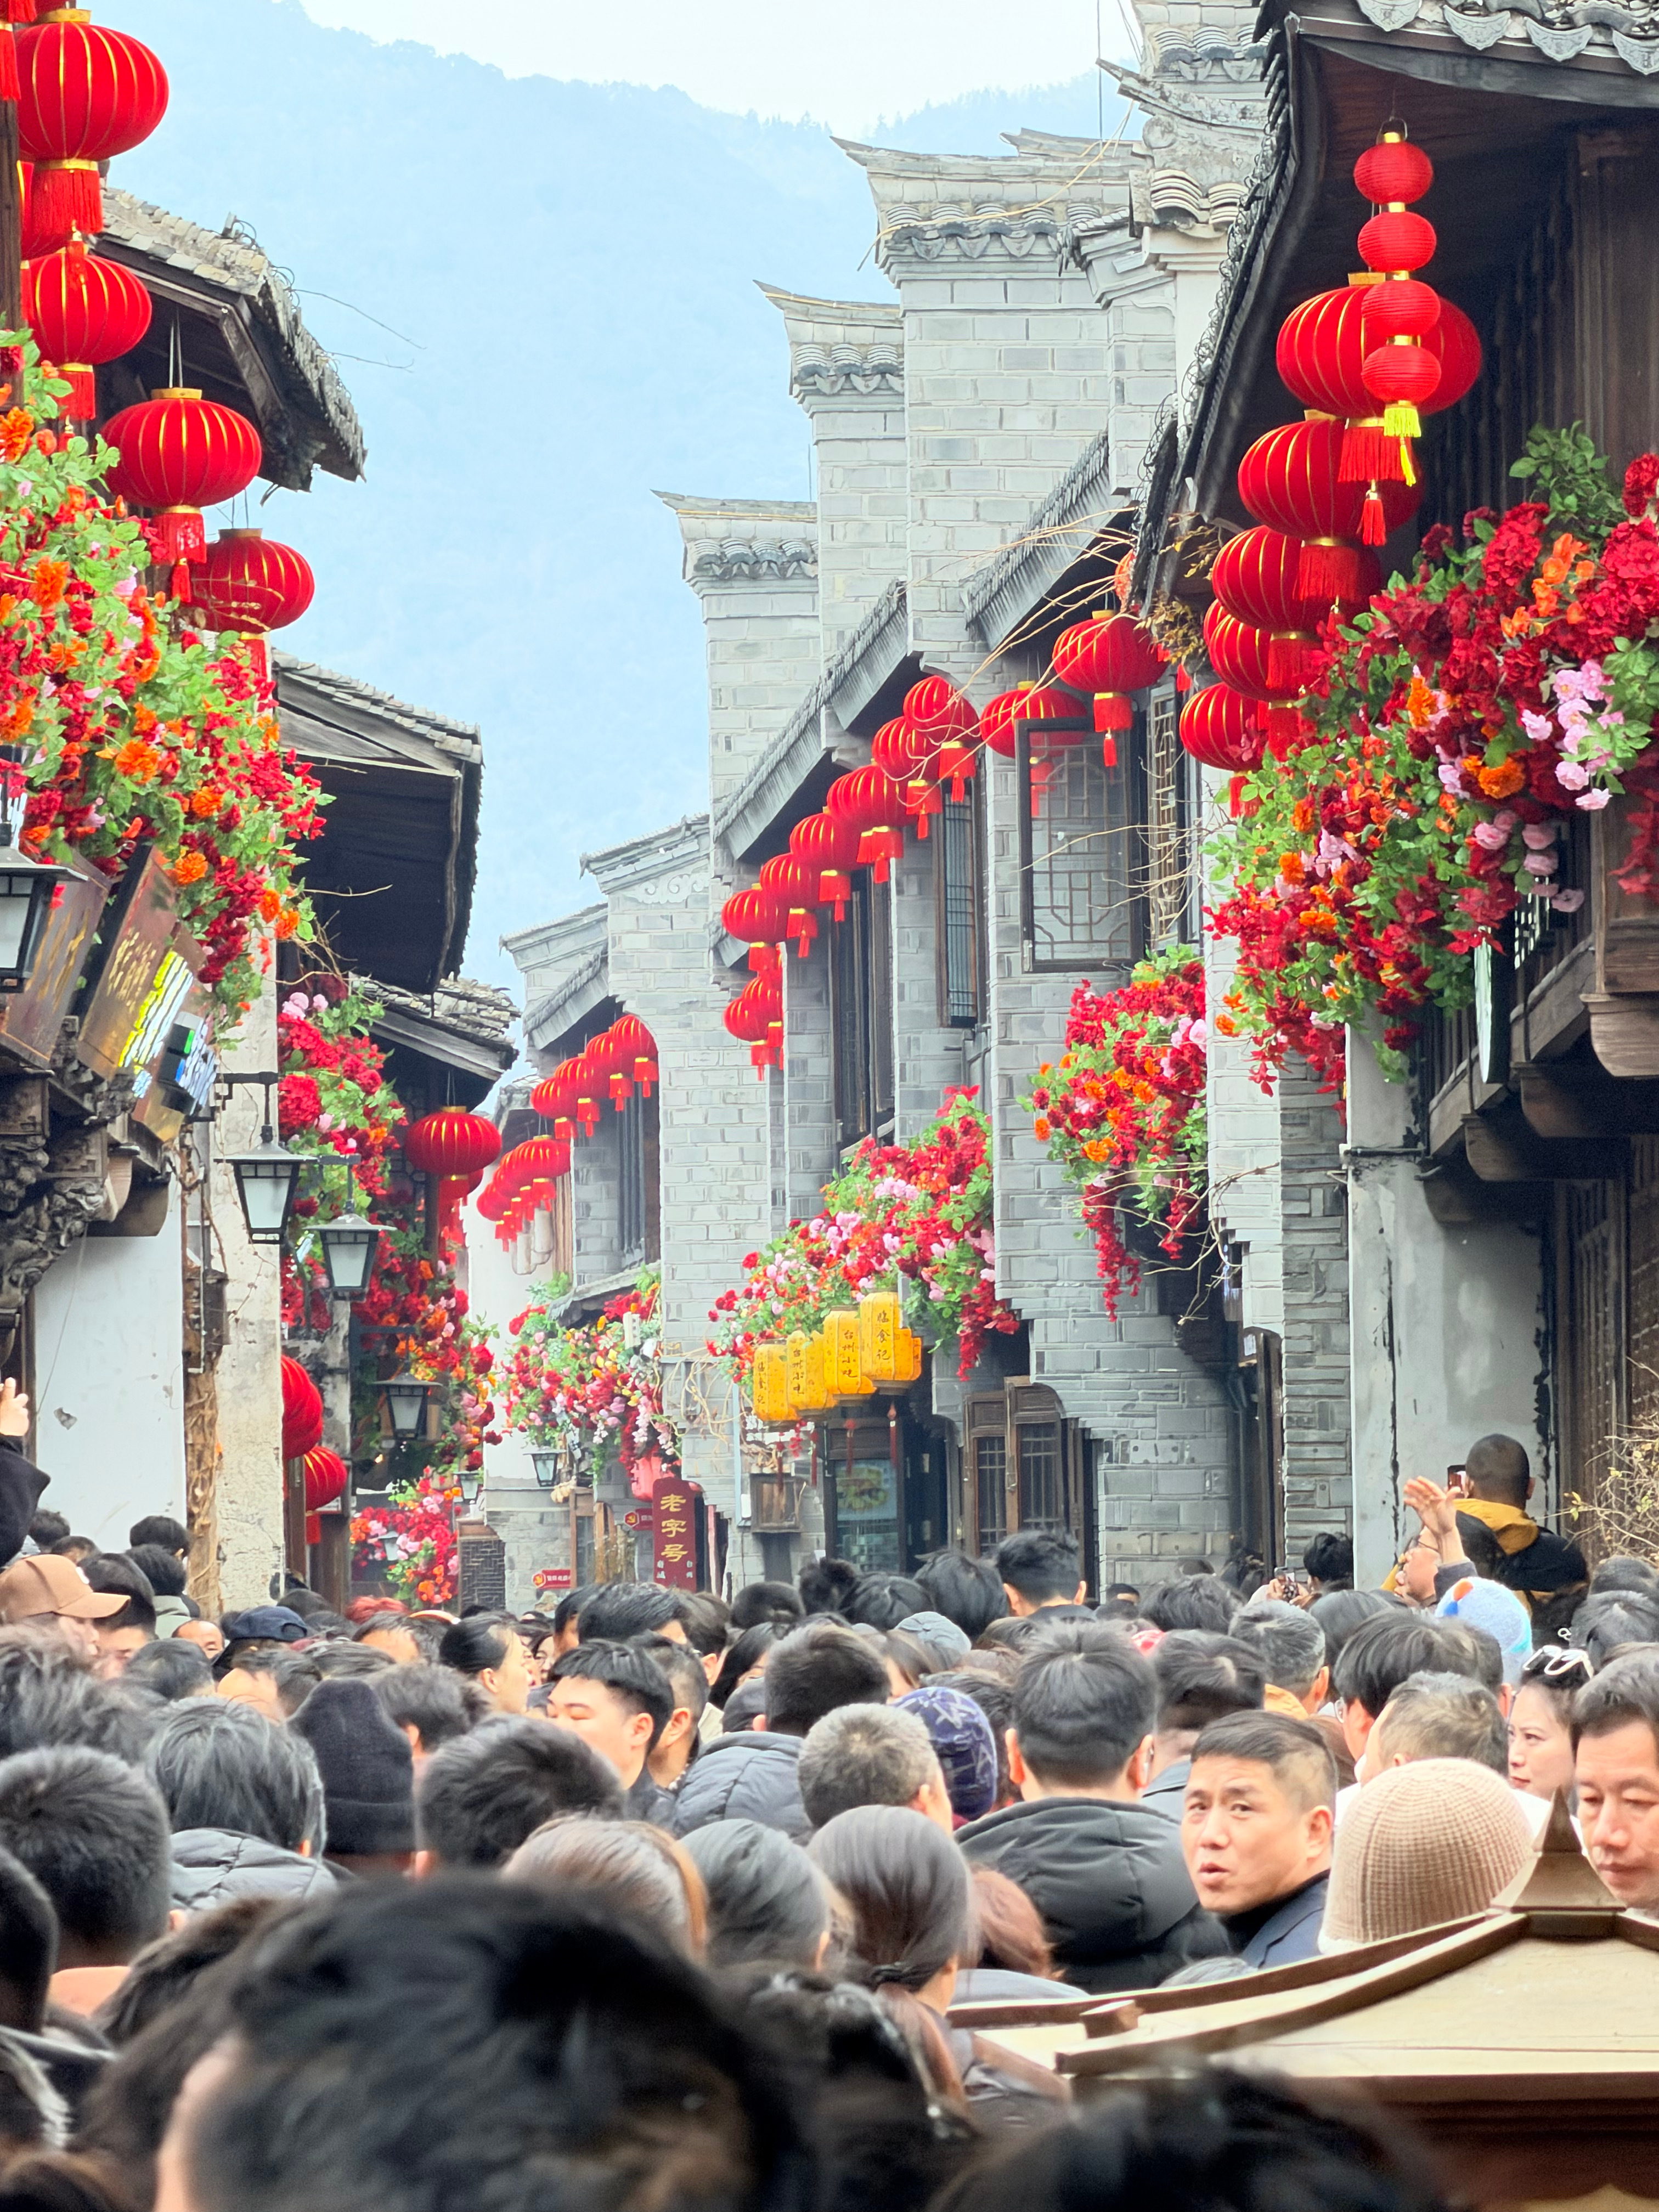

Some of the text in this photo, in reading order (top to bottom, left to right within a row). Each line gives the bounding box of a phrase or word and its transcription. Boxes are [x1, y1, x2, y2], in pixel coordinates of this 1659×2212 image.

[842, 1330, 858, 1378] 台州小吃
[660, 1493, 688, 1562] 老字号
